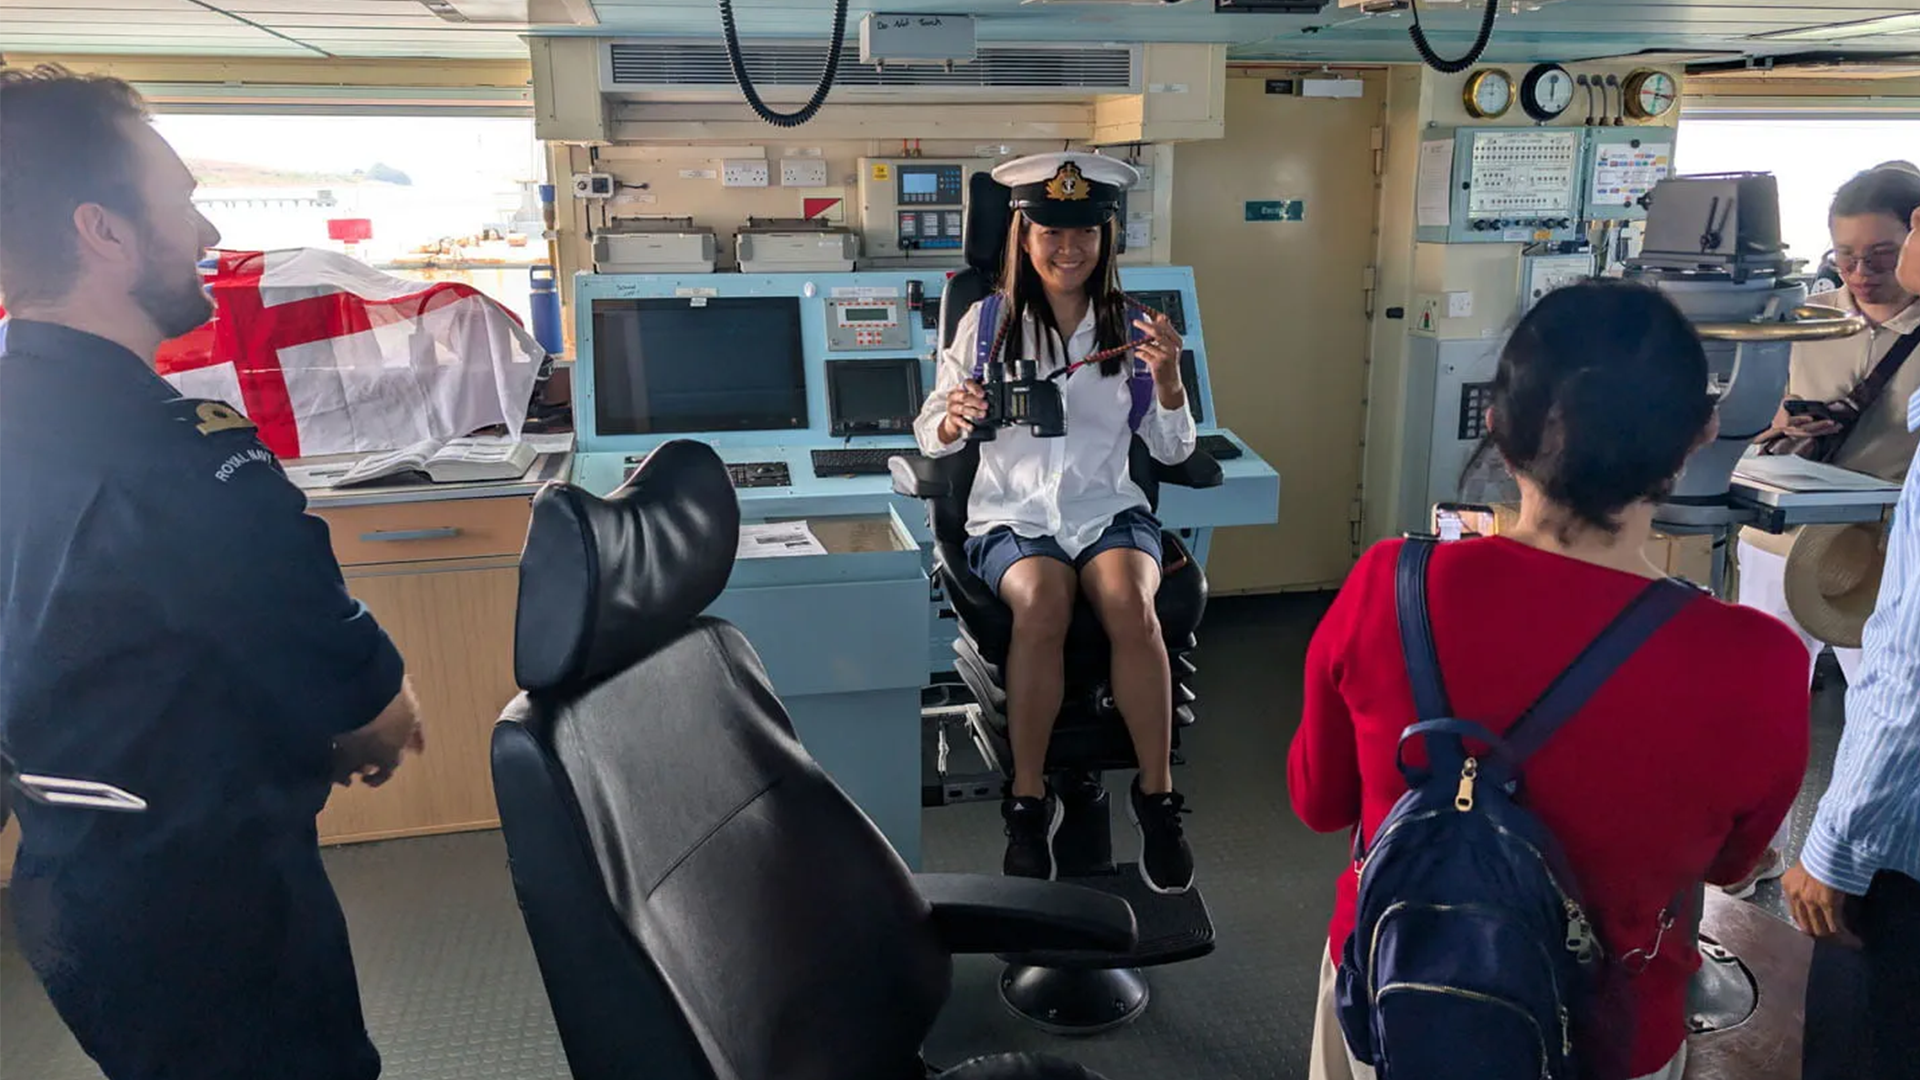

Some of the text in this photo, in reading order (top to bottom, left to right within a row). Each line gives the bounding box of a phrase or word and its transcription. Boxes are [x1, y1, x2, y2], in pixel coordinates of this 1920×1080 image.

[877, 20, 889, 30] Do
[894, 18, 909, 28] Not
[214, 452, 250, 482] ROYAL
